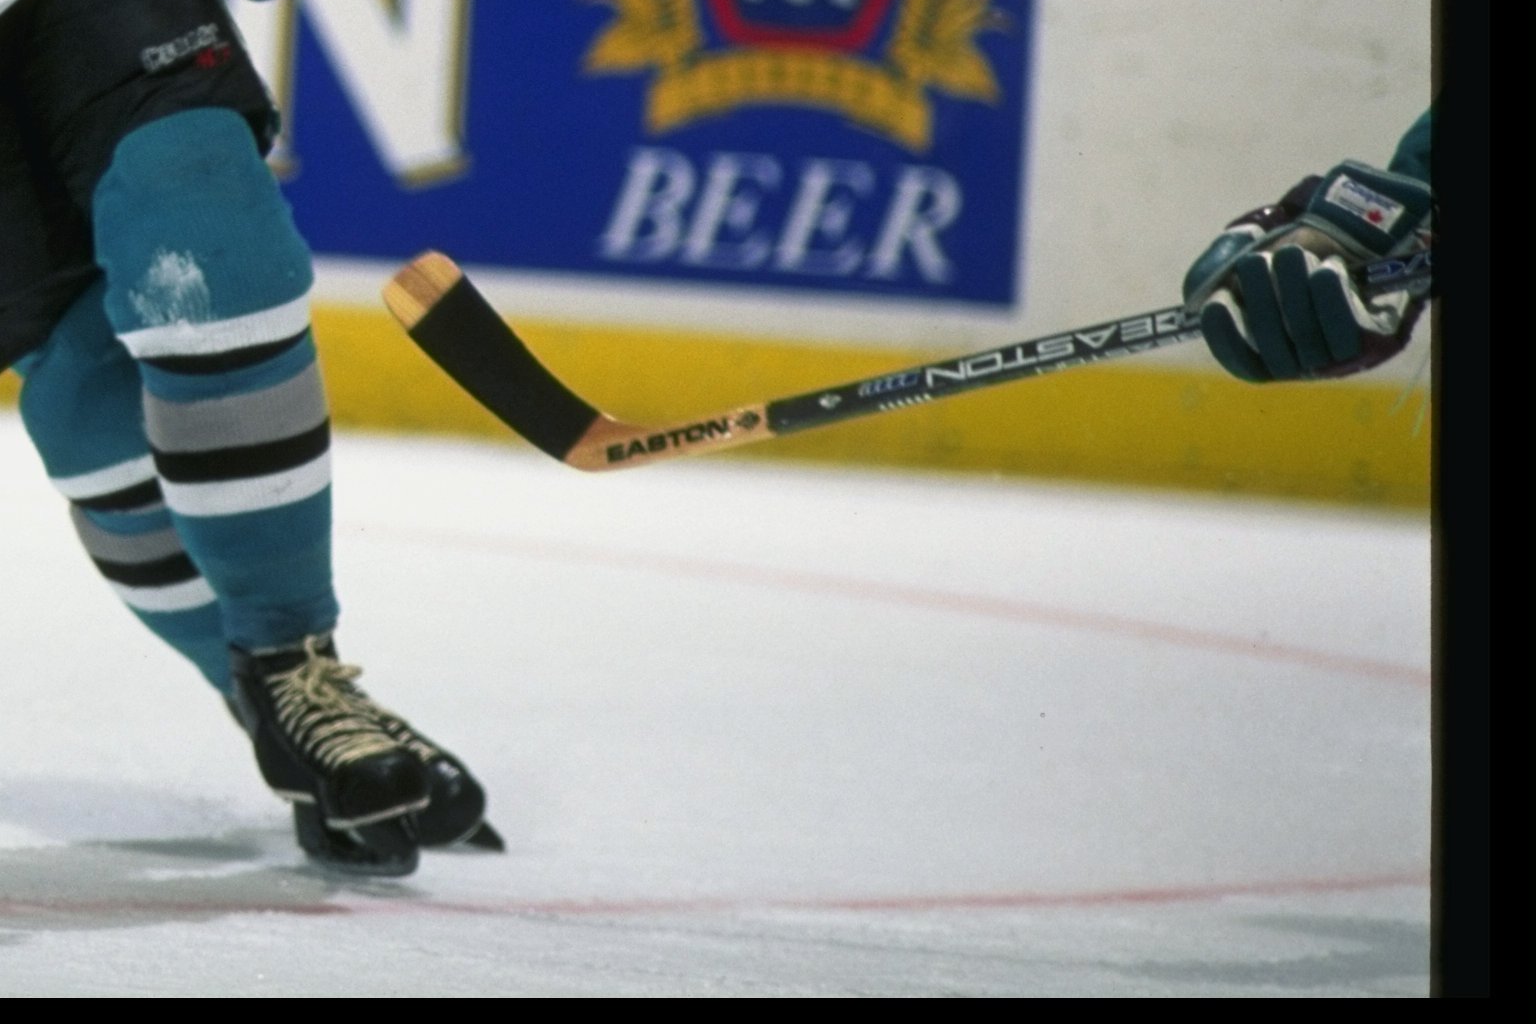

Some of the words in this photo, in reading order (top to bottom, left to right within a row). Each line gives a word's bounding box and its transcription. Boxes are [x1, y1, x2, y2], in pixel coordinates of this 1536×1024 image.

[596, 143, 964, 288] BEER
[924, 312, 1172, 389] EASTON
[606, 418, 732, 465] EASTON
